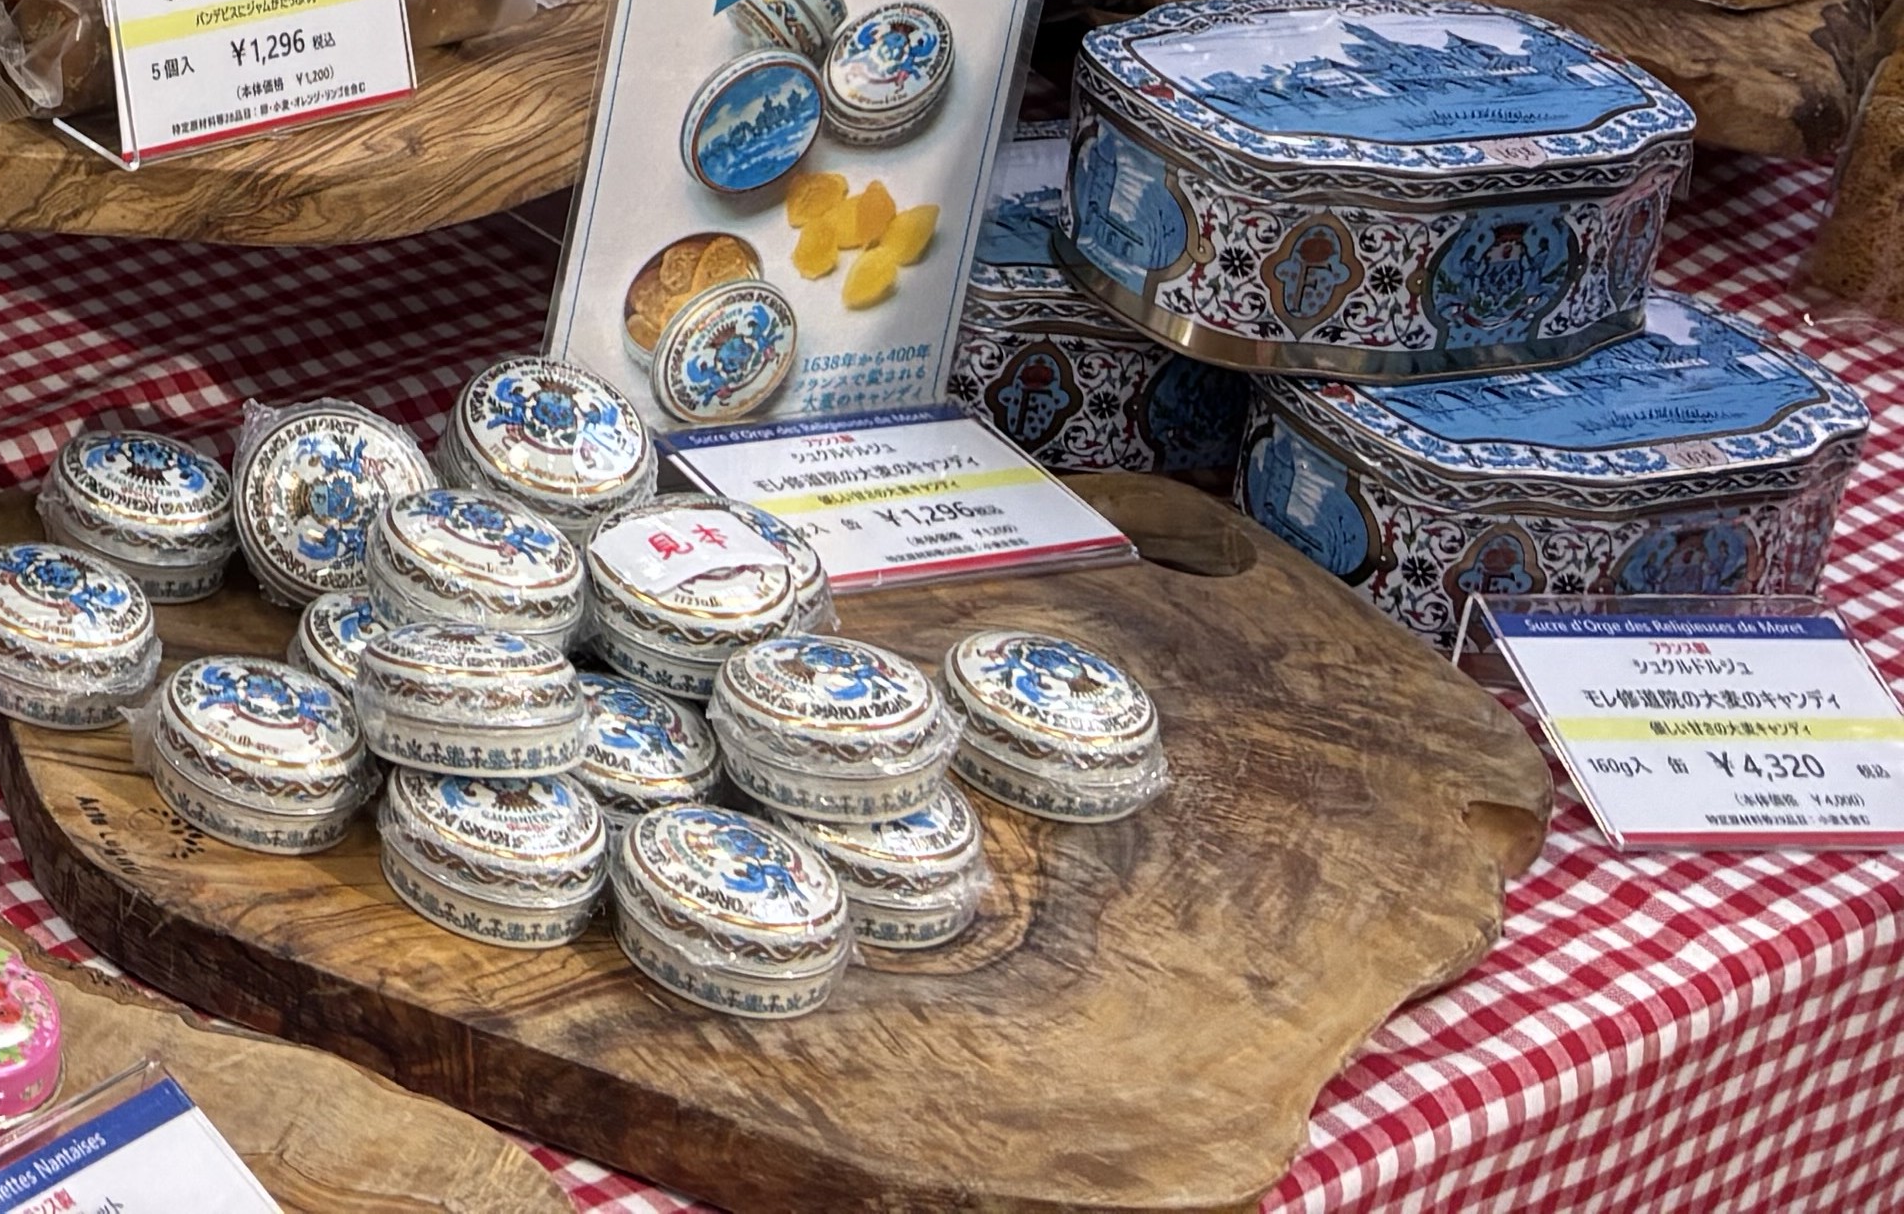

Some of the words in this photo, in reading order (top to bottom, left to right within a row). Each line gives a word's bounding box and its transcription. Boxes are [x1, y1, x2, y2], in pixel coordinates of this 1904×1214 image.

[231, 29, 305, 67] ¥1,296
[151, 56, 195, 82] ５個入
[647, 523, 729, 562] 見本
[1525, 618, 1568, 634] Sucre
[1572, 617, 1621, 636] d'Orge
[1625, 619, 1651, 634] des
[1655, 618, 1734, 636] Religieuses
[1738, 620, 1755, 634] de
[1758, 620, 1804, 635] Moret
[1707, 751, 1825, 780] ¥4,320
[34, 1130, 107, 1184] Nantaises
